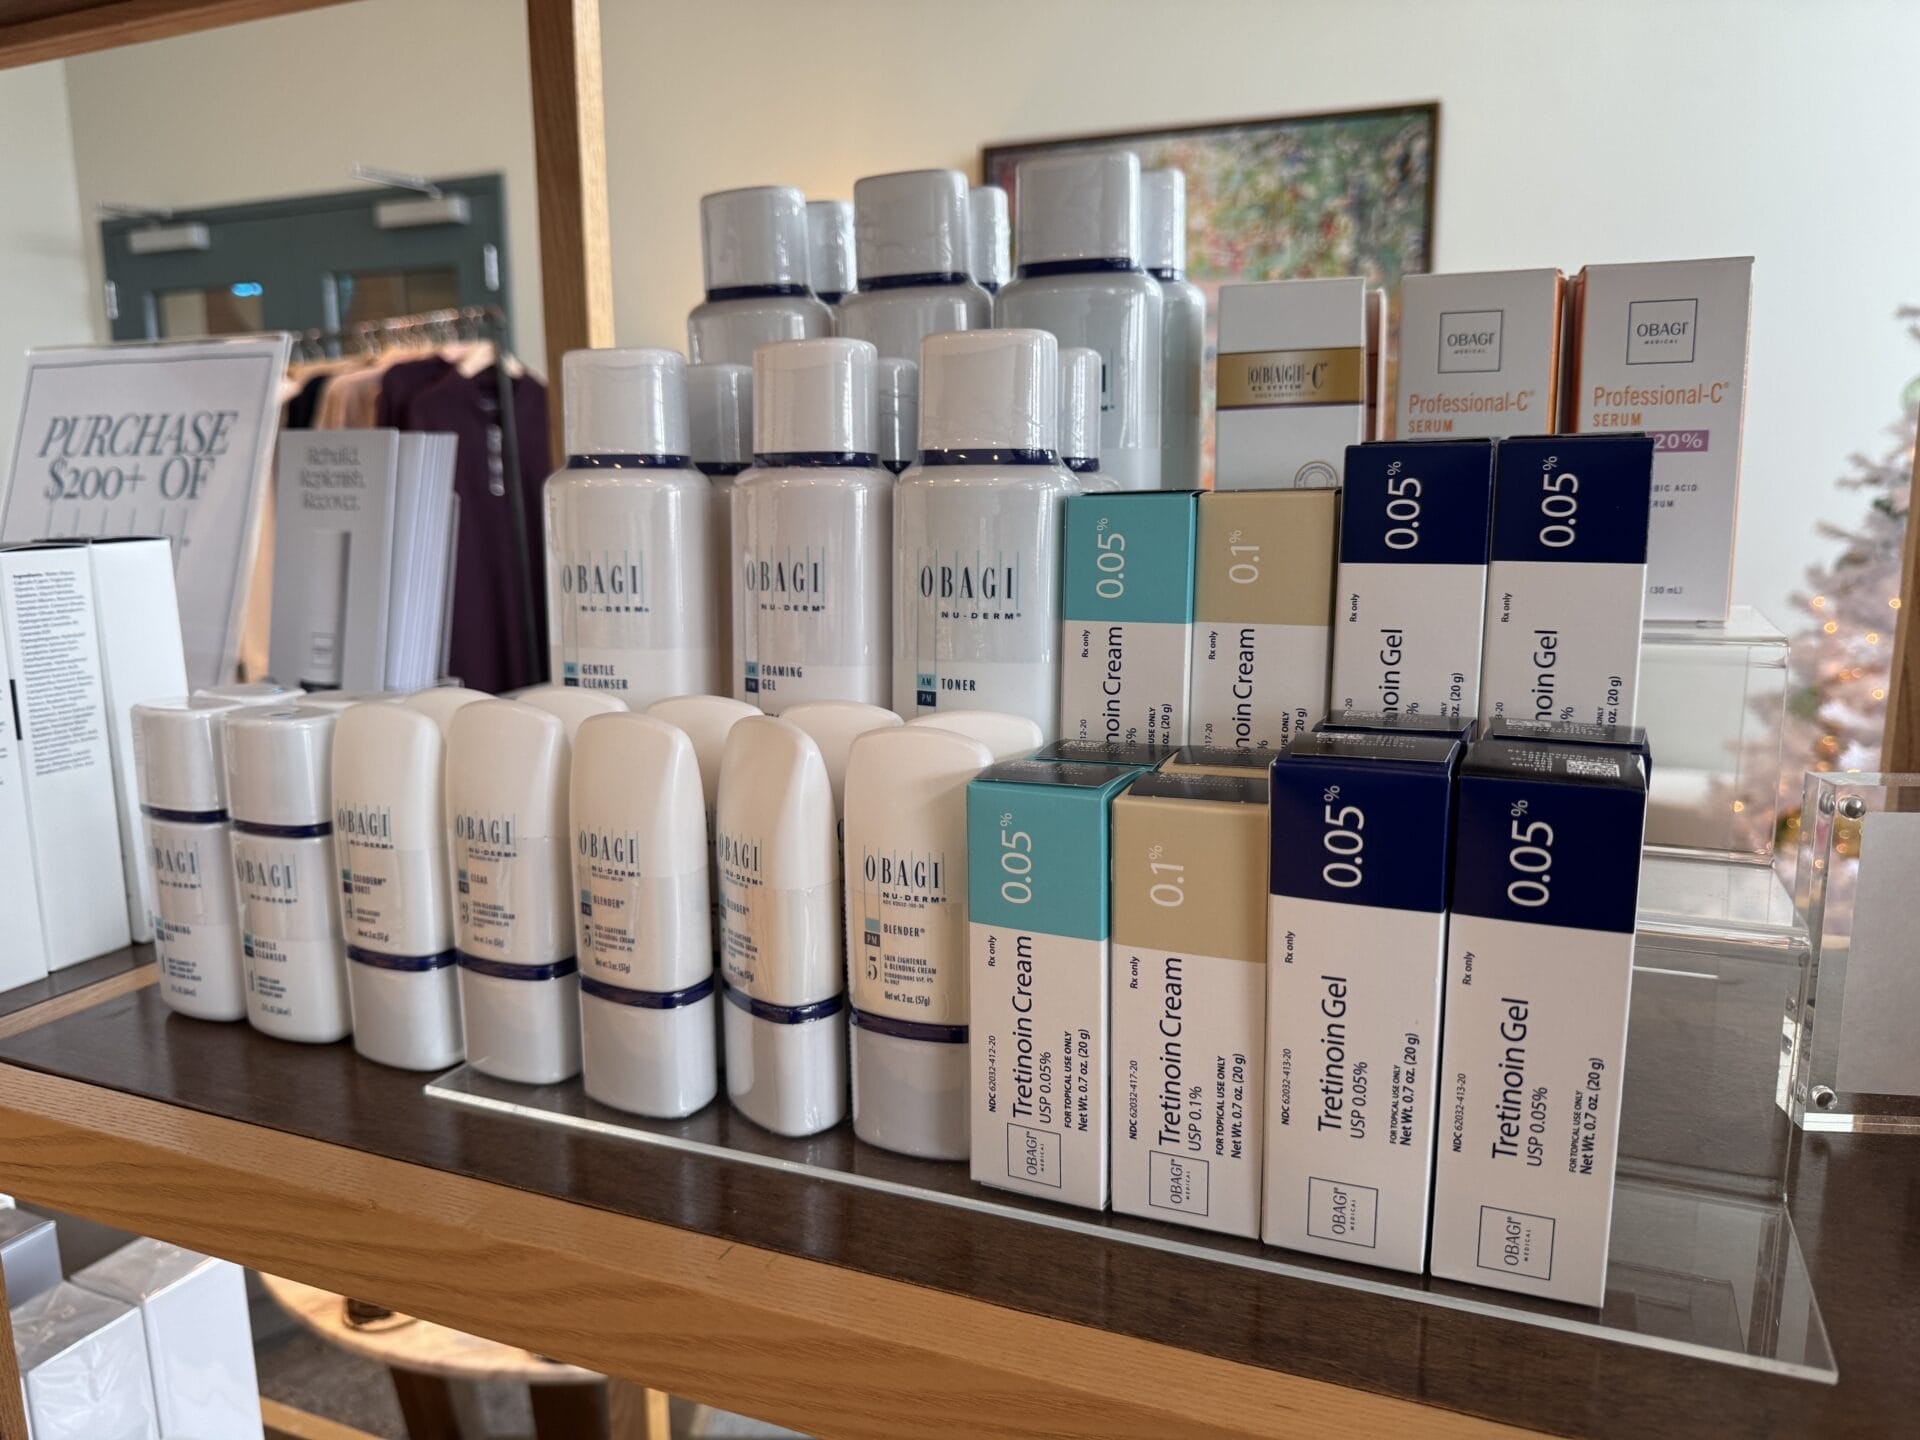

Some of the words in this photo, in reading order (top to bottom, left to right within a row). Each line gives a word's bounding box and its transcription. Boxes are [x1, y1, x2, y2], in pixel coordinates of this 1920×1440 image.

[1408, 420, 1453, 433] SERUM
[1593, 413, 1642, 427] SERUM
[39, 410, 239, 458] PURCHASE
[1654, 433, 1702, 449] 20%
[44, 456, 146, 503] $200+
[159, 455, 215, 500] OF
[1675, 484, 1698, 492] ACID
[1384, 461, 1422, 550] 0.05%
[1539, 456, 1579, 548] 0.05%
[1096, 518, 1126, 599] 0.05%
[1229, 530, 1260, 584] 0.1%
[562, 564, 639, 594] OBAGI
[746, 560, 819, 593] OBAGI
[920, 565, 1014, 599] OBAGI
[1350, 593, 1360, 609] only
[1502, 593, 1512, 609] only
[1350, 611, 1357, 622] Rx
[1502, 611, 1509, 623] Rx
[1082, 629, 1091, 645] only
[1209, 631, 1219, 648] only
[1082, 646, 1089, 658] Rx
[1209, 648, 1216, 660] Rx
[1380, 629, 1403, 666] Gel
[1533, 630, 1558, 669] Gel
[582, 664, 615, 676] GENTLE
[1103, 626, 1122, 696] Cream
[1233, 628, 1255, 699] Cream
[761, 664, 802, 678] FOAMING
[1452, 672, 1464, 683] g)
[582, 678, 629, 689] CLEANSER
[761, 679, 776, 690] GEL
[921, 677, 931, 686] AM
[941, 678, 976, 691] TONER
[1608, 676, 1622, 687] g)
[1451, 684, 1461, 701] (20
[1607, 688, 1619, 706] (20
[1162, 703, 1172, 715] g)
[1297, 707, 1308, 719] g)
[1162, 716, 1171, 731] (20
[338, 808, 387, 837] OBAGI
[457, 814, 511, 845] OBAGI
[1323, 785, 1365, 888] 0.05%
[579, 831, 635, 864] OBAGI
[719, 832, 758, 872] OBAGI
[1507, 800, 1553, 907] 0.05%
[156, 848, 196, 875] BAGI
[1000, 813, 1032, 904] 0.05%
[866, 855, 940, 888] OBAGI
[1148, 845, 1184, 907] 0.1%
[988, 935, 997, 954] only
[1285, 930, 1296, 949] only
[988, 956, 995, 967] Rx
[1130, 957, 1141, 975] only
[1285, 951, 1294, 963] Rx
[1464, 951, 1476, 972] only
[868, 956, 878, 981] 5
[1012, 936, 1032, 1013] Cream
[1130, 976, 1138, 989] Rx
[1462, 973, 1471, 986] Rx
[1159, 957, 1182, 1038] Cream
[1321, 976, 1347, 1019] Gel
[1501, 997, 1529, 1042] Gel
[1064, 1031, 1072, 1054] ONLY
[1078, 1029, 1091, 1040] g)
[1405, 1033, 1420, 1045] g)
[1078, 1042, 1090, 1058] (20
[1232, 1054, 1246, 1065] g)
[1404, 1047, 1418, 1065] (20
[989, 1036, 997, 1092] 62032-412-20
[1012, 1017, 1032, 1119] Tretinoin
[1039, 1052, 1051, 1094] 0.05%
[1064, 1056, 1072, 1073] USE
[1080, 1060, 1088, 1076] oz.
[1217, 1056, 1226, 1079] ONLY
[1588, 1058, 1605, 1070] g)
[1232, 1066, 1245, 1083] (20
[1282, 1049, 1291, 1104] 62032-413-20
[1318, 1024, 1345, 1132] Tretinoin
[1393, 1064, 1401, 1084] ONLY
[1405, 1068, 1415, 1085] oz.
[1587, 1071, 1601, 1091] (20
[1078, 1077, 1088, 1093] 0.7
[1129, 1060, 1138, 1118] 62032-417-20
[1217, 1081, 1225, 1099] USE
[1233, 1086, 1243, 1101] oz.
[1352, 1061, 1368, 1107] 0.05%
[1392, 1085, 1400, 1099] USE
[989, 1093, 997, 1113] NDC
[1078, 1095, 1088, 1112] Wt.
[1158, 1043, 1181, 1146] Tretinoin
[1189, 1087, 1202, 1121] 0.1%
[1402, 1086, 1414, 1103] 0.7
[1455, 1074, 1466, 1131] 62032-413-20
[1491, 1048, 1524, 1159] Tretinoin
[1574, 1091, 1583, 1111] ONLY
[1587, 1093, 1599, 1110] oz.
[1039, 1097, 1051, 1124] USP
[1216, 1100, 1224, 1137] TOPICAL
[1232, 1103, 1242, 1119] 0.7
[1281, 1105, 1290, 1126] NDC
[1391, 1100, 1399, 1129] TOPICAL
[1401, 1106, 1413, 1124] Wt.
[1530, 1087, 1548, 1134] 0.05%
[1573, 1111, 1581, 1126] USE
[1078, 1113, 1088, 1131] Net
[1129, 1119, 1137, 1140] NDC
[1231, 1122, 1242, 1138] Wt.
[1350, 1110, 1365, 1139] USP
[1584, 1112, 1597, 1131] 0.7
[1188, 1123, 1201, 1151] USP
[1400, 1126, 1412, 1146] Net
[1453, 1132, 1463, 1153] NDC
[1570, 1127, 1580, 1158] TOPICAL
[1581, 1133, 1595, 1152] Wt.
[1216, 1138, 1224, 1155] FOR
[1231, 1140, 1242, 1159] Net
[1527, 1137, 1543, 1167] USP
[1569, 1158, 1577, 1174] FOR
[1580, 1154, 1593, 1175] Net
